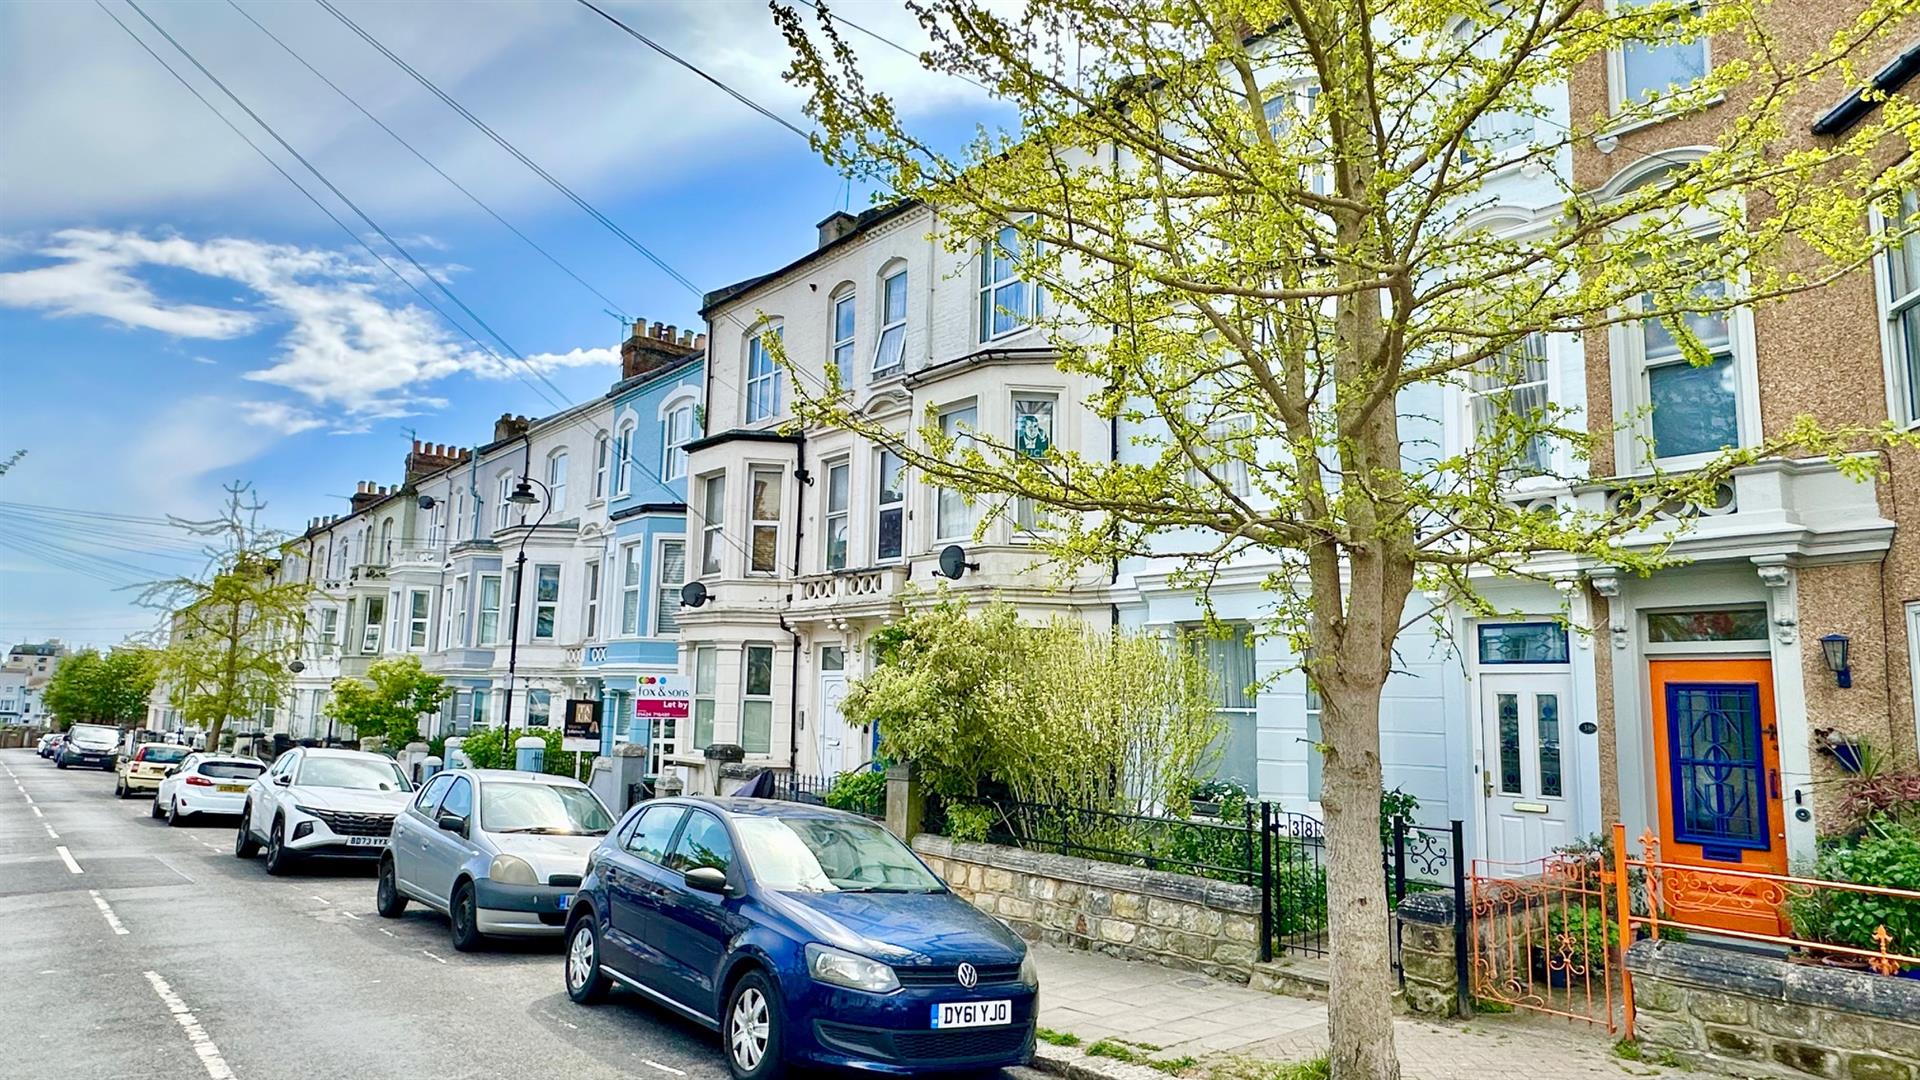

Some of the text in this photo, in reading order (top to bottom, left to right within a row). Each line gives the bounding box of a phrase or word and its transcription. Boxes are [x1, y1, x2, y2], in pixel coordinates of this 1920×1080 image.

[638, 686, 689, 697] fox & sons
[678, 701, 688, 710] by
[1292, 821, 1313, 838] 38
[944, 1003, 1006, 1024] DY61 YJO
